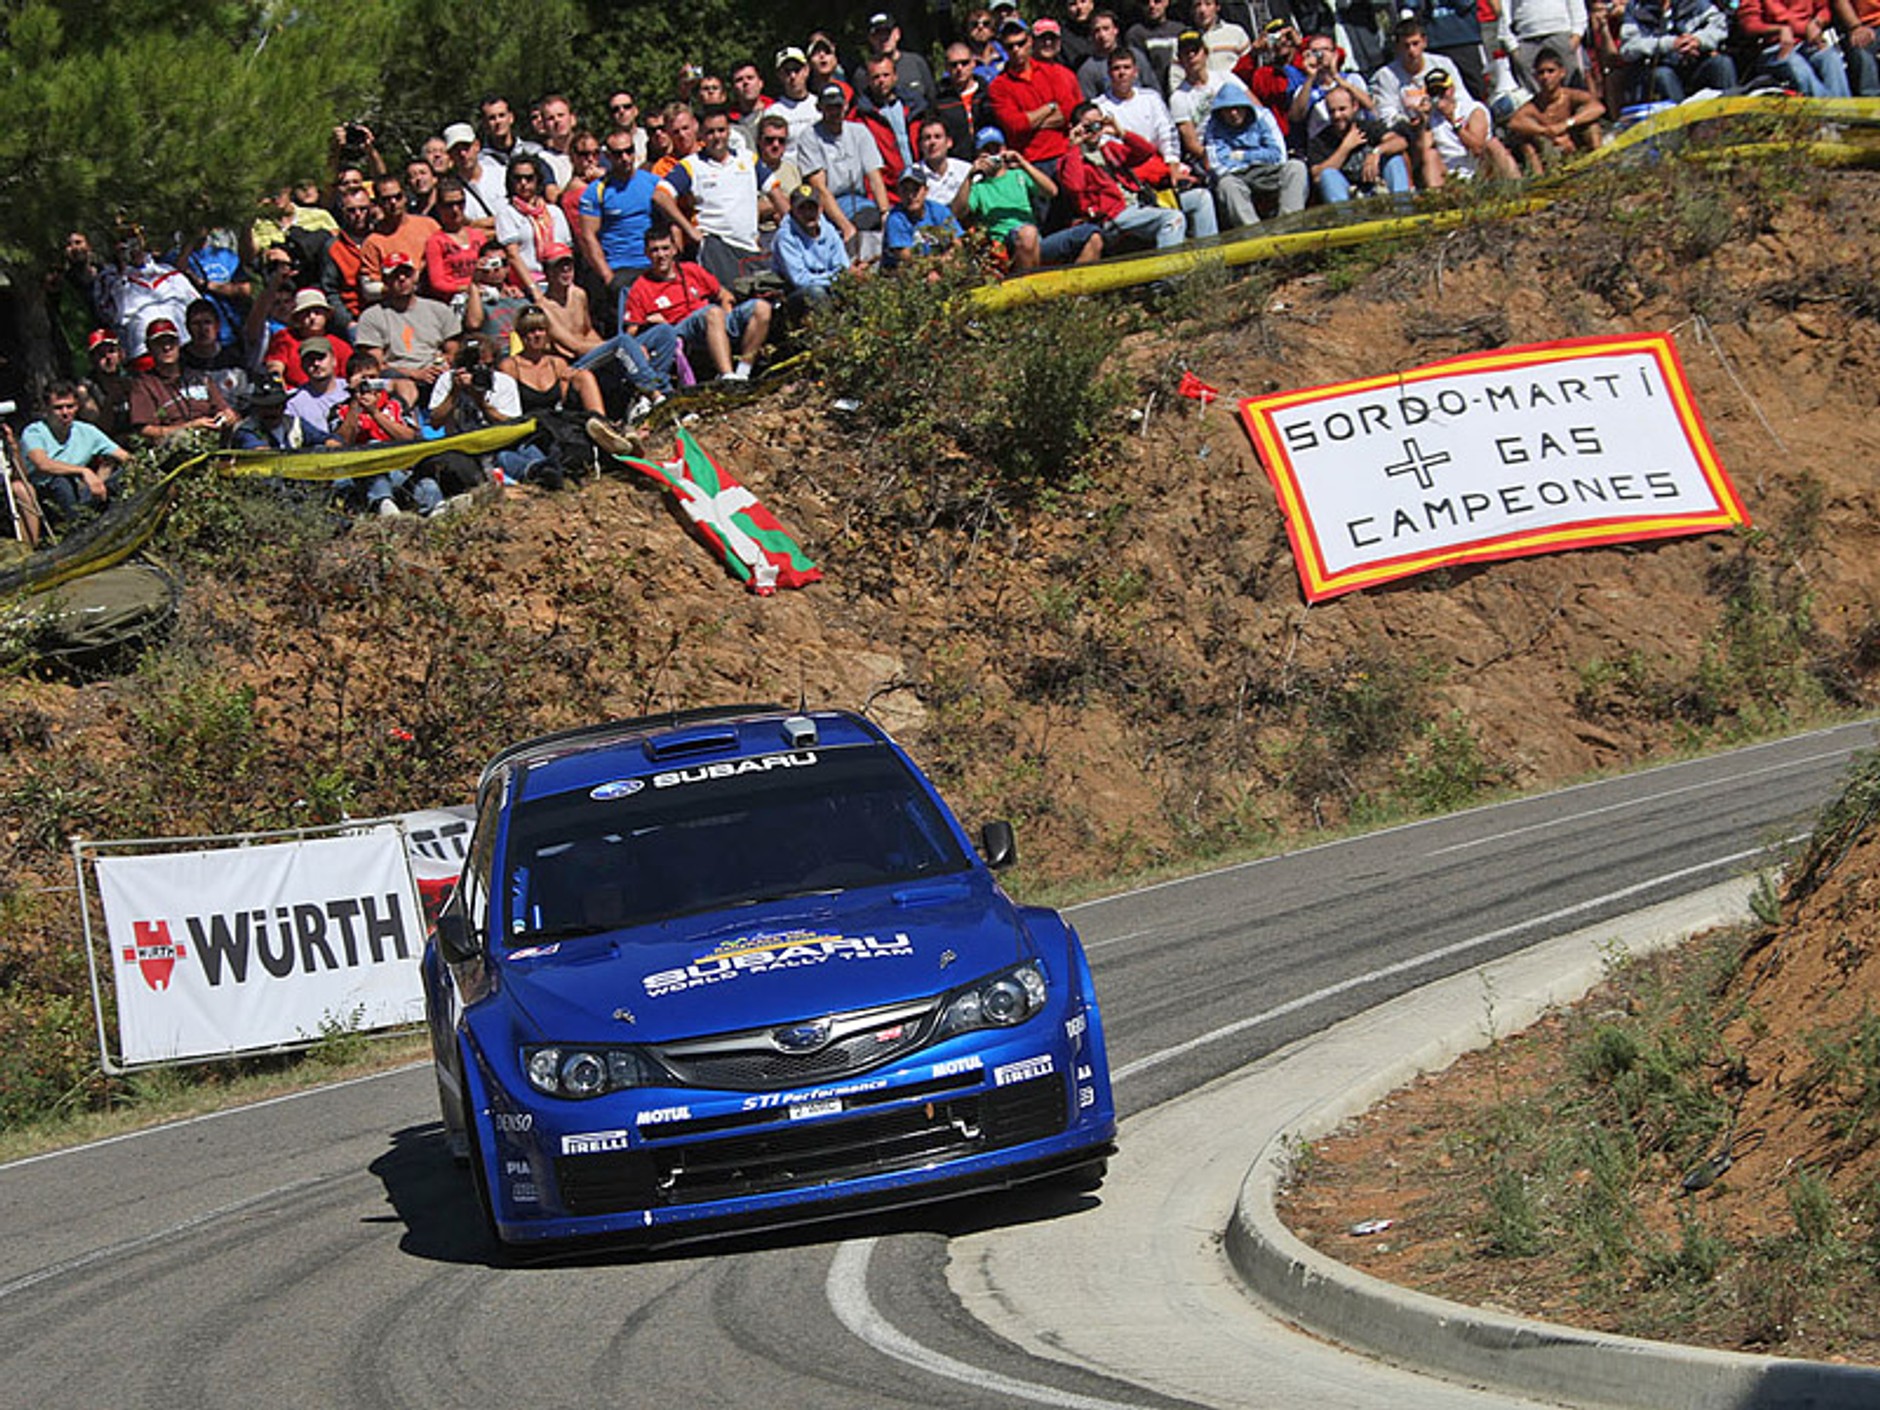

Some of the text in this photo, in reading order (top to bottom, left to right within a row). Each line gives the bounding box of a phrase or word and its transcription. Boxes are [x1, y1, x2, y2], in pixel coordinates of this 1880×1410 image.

[1284, 366, 1655, 452] SORDO-MARTÍ
[1494, 426, 1604, 465] GAS
[1346, 472, 1681, 549] CAMPEONES
[652, 752, 818, 788] SUBARU
[186, 892, 410, 987] WÜRTH
[642, 934, 911, 989] SUBARU
[647, 947, 914, 998] WORLD RALLY TEAM
[931, 1054, 985, 1079] MOTUL
[993, 1053, 1055, 1087] PIRELLI
[741, 1092, 782, 1112] STI
[782, 1079, 889, 1104] Performance
[635, 1105, 693, 1126] MOTUL
[561, 1129, 629, 1155] PIRELLI
